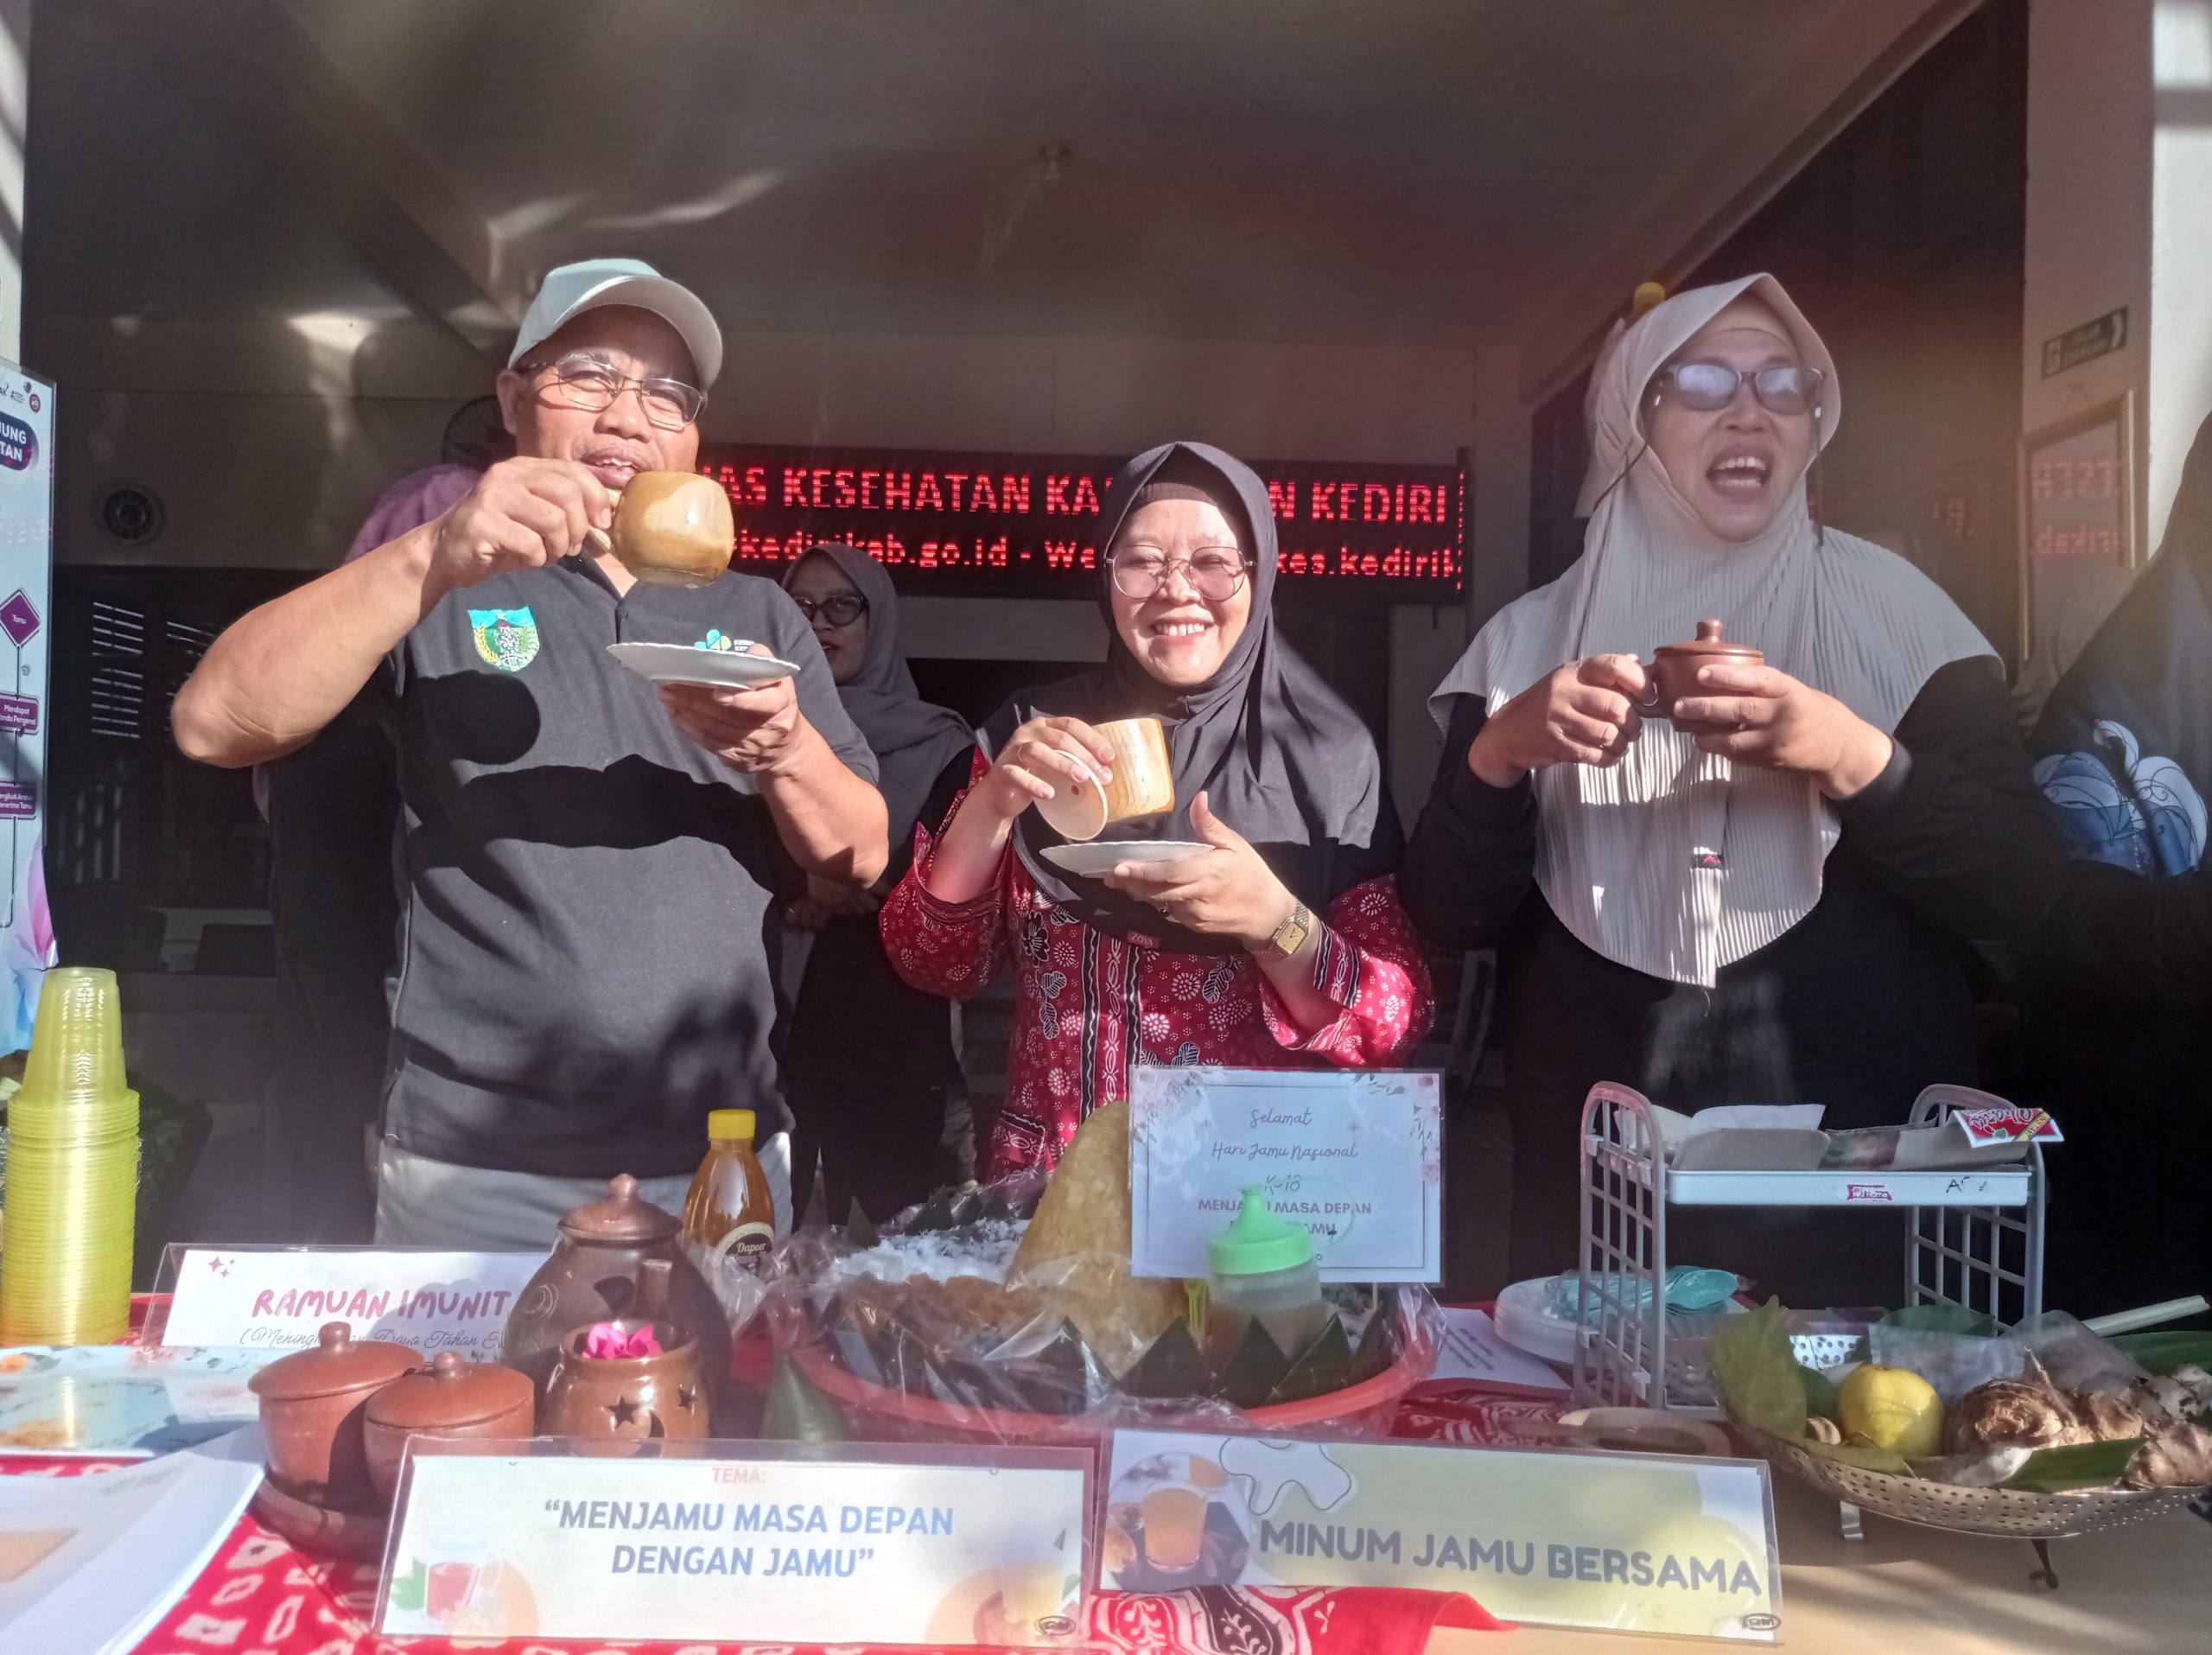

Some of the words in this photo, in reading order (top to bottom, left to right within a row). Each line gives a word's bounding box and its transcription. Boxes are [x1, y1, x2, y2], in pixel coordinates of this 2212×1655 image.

[0, 422, 27, 445] UNG
[703, 466, 766, 505] AS
[784, 468, 1030, 515] KESEHATAN
[1312, 481, 1446, 524] KEDIRI
[1250, 1107, 1313, 1129] Selamat
[1211, 1142, 1247, 1161] Hari
[1248, 1143, 1290, 1161] Jamu
[1274, 1201, 1320, 1214] MASA
[1324, 1202, 1371, 1214] DEPAN
[737, 1242, 767, 1255] Dapoer
[251, 1289, 391, 1320] RAMUAN
[397, 1289, 512, 1321] IMUNIT
[712, 1467, 766, 1484] TEMA:
[734, 1504, 828, 1533] MASA
[839, 1505, 954, 1536] DEPAN
[611, 1544, 754, 1575] DENGAN
[1260, 1519, 1402, 1565] MINUM
[1412, 1533, 1535, 1576] JAMU
[1547, 1543, 1763, 1597] BERSAMA
